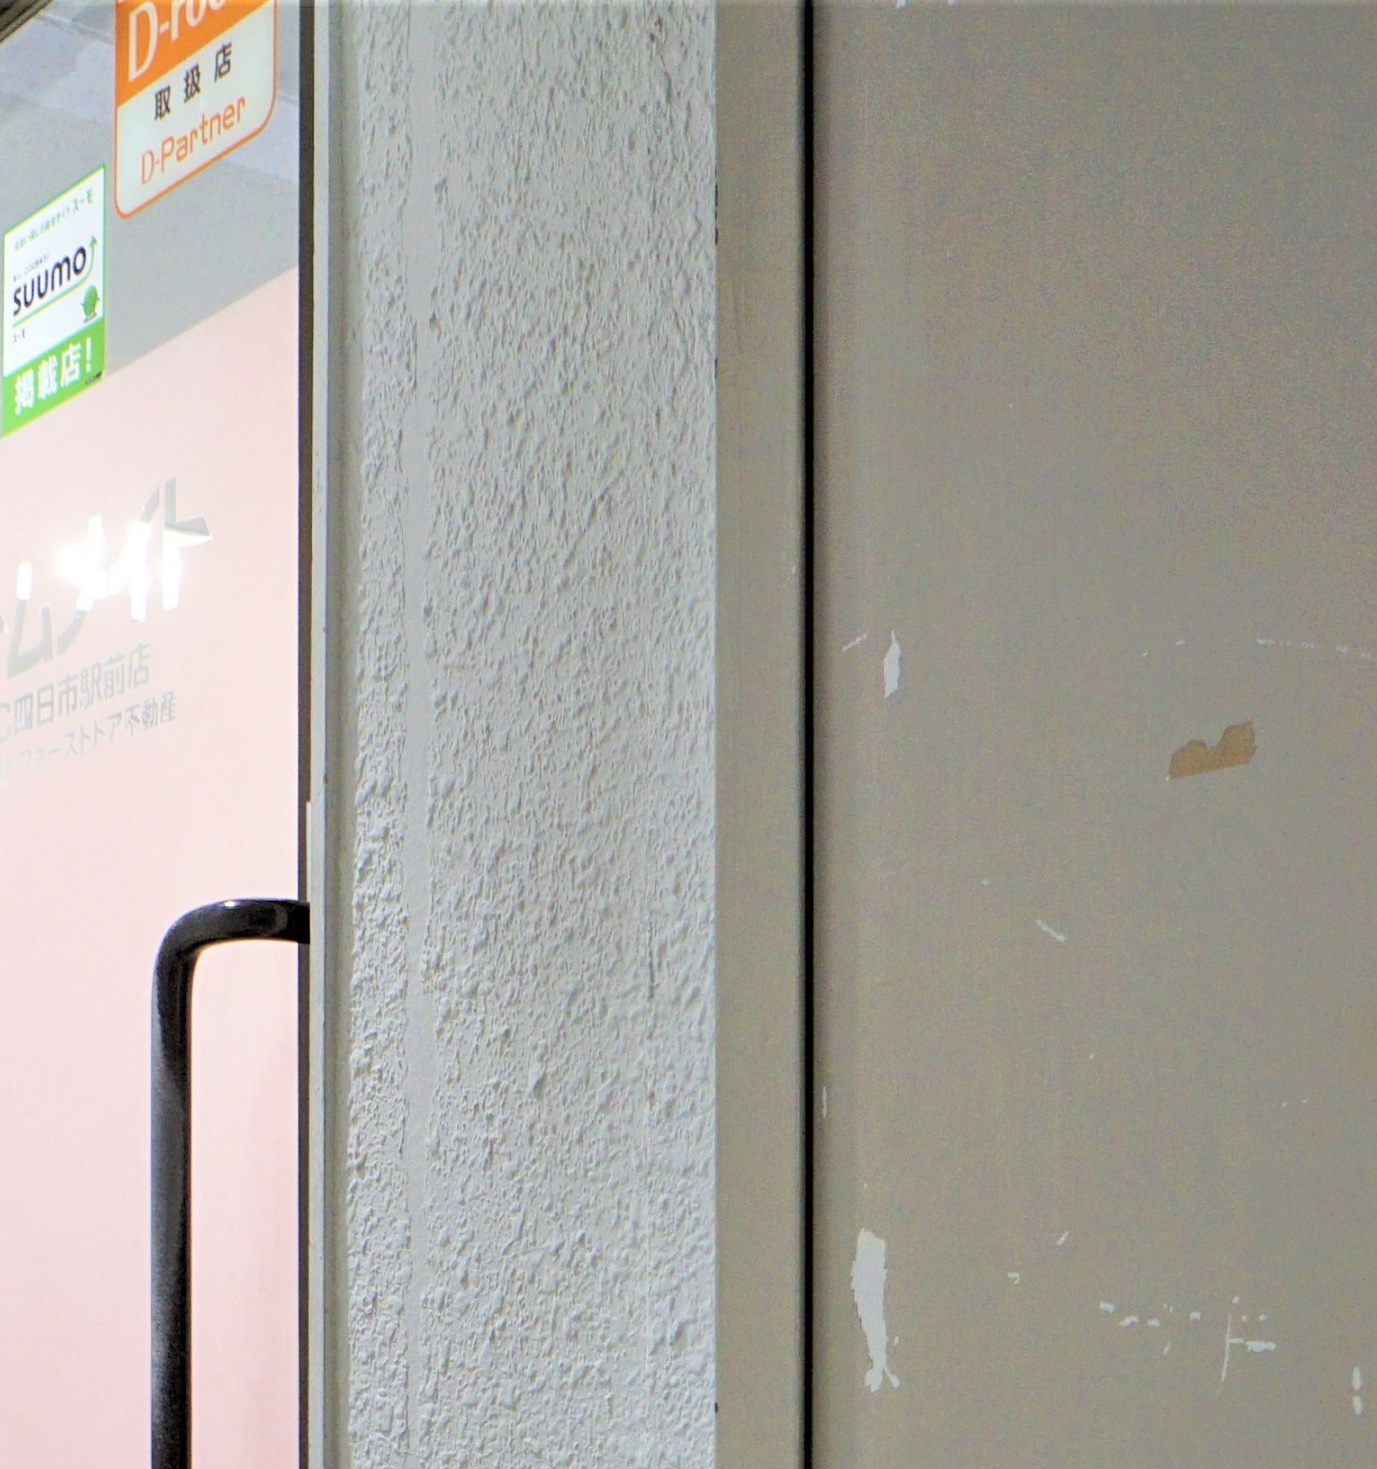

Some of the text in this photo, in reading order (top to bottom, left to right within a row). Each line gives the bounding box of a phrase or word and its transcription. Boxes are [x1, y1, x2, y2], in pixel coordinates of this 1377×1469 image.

[128, 0, 227, 83] D-ro
[154, 41, 232, 121] 取扱店
[140, 96, 246, 185] D-Partner
